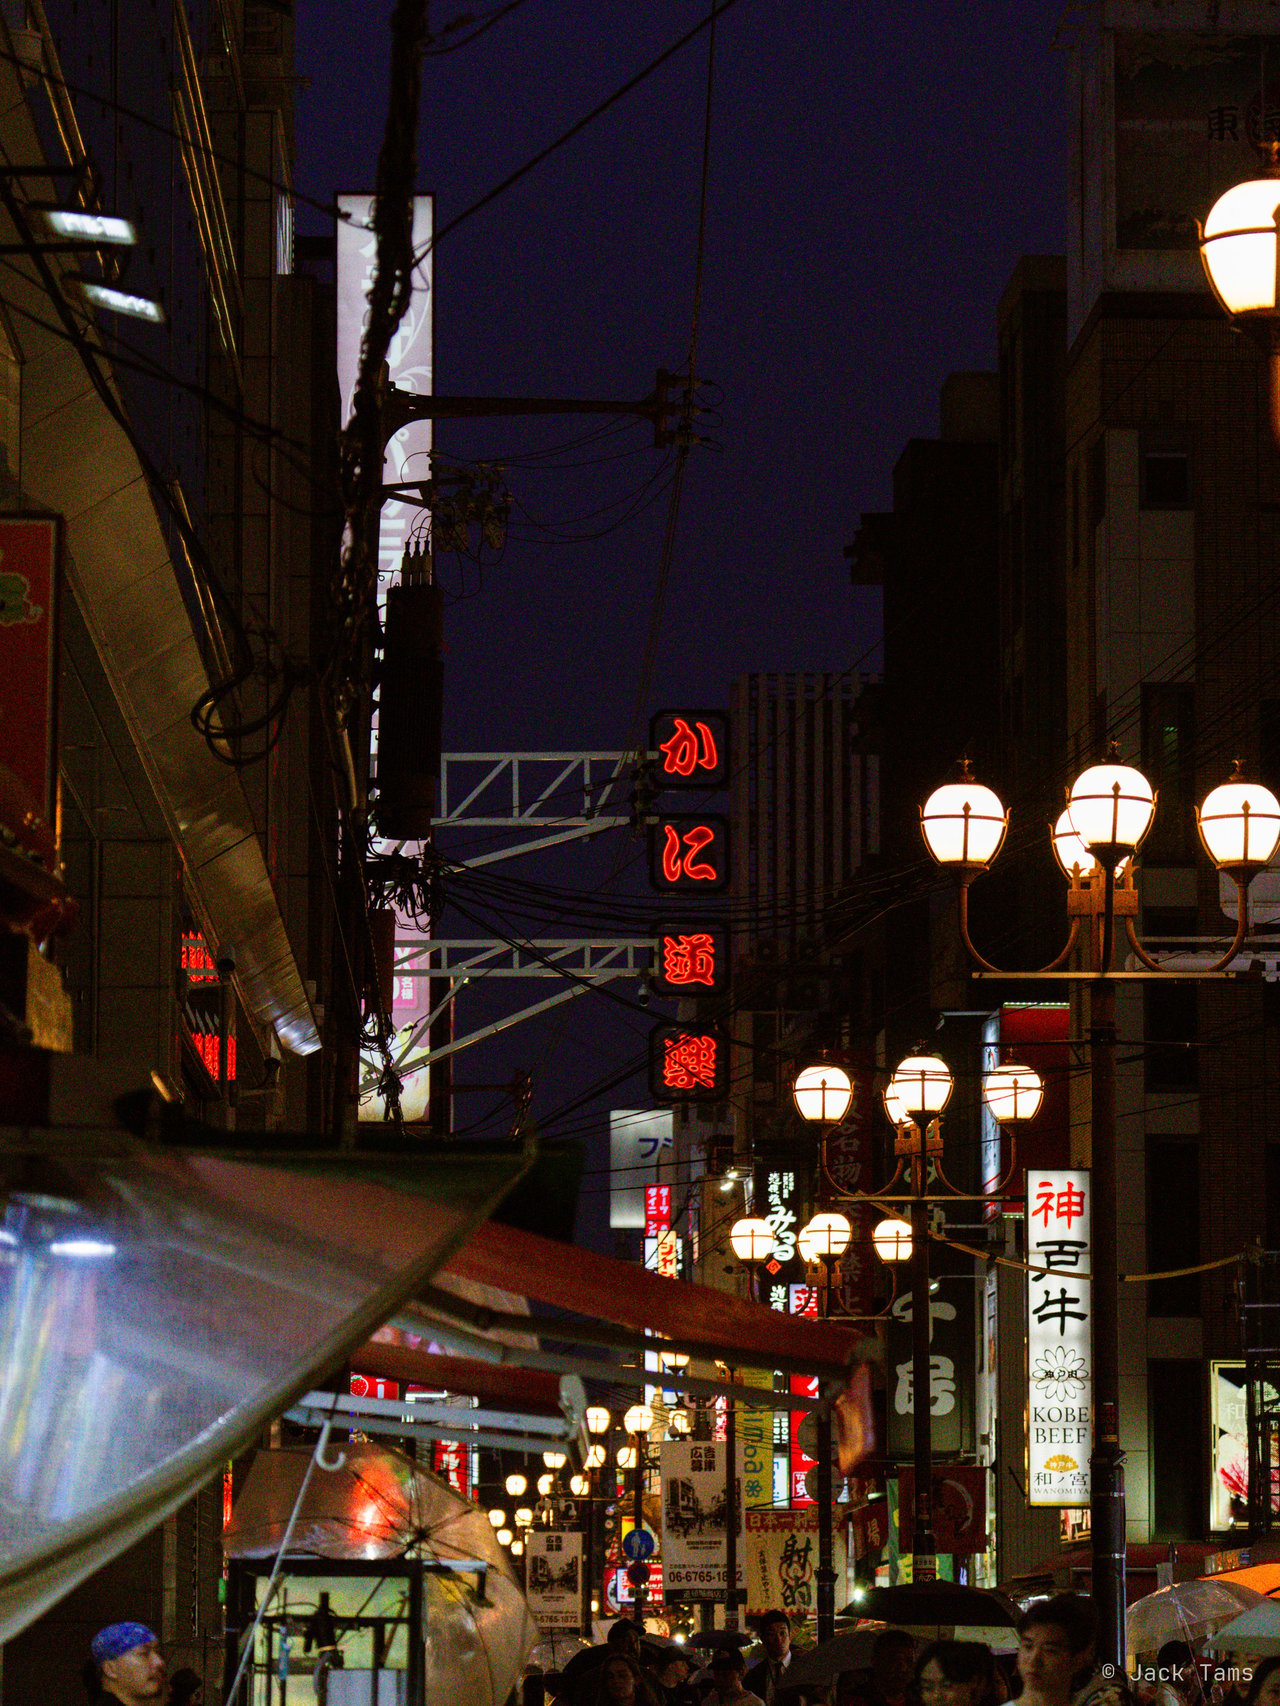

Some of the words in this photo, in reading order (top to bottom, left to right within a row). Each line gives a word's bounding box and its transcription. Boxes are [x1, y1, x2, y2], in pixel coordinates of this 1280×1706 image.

[1031, 1181, 1089, 1337] 神戸牛
[1033, 1407, 1090, 1423] KOBE
[1035, 1427, 1088, 1444] BEEF
[668, 1571, 743, 1583] 06-6765-182
